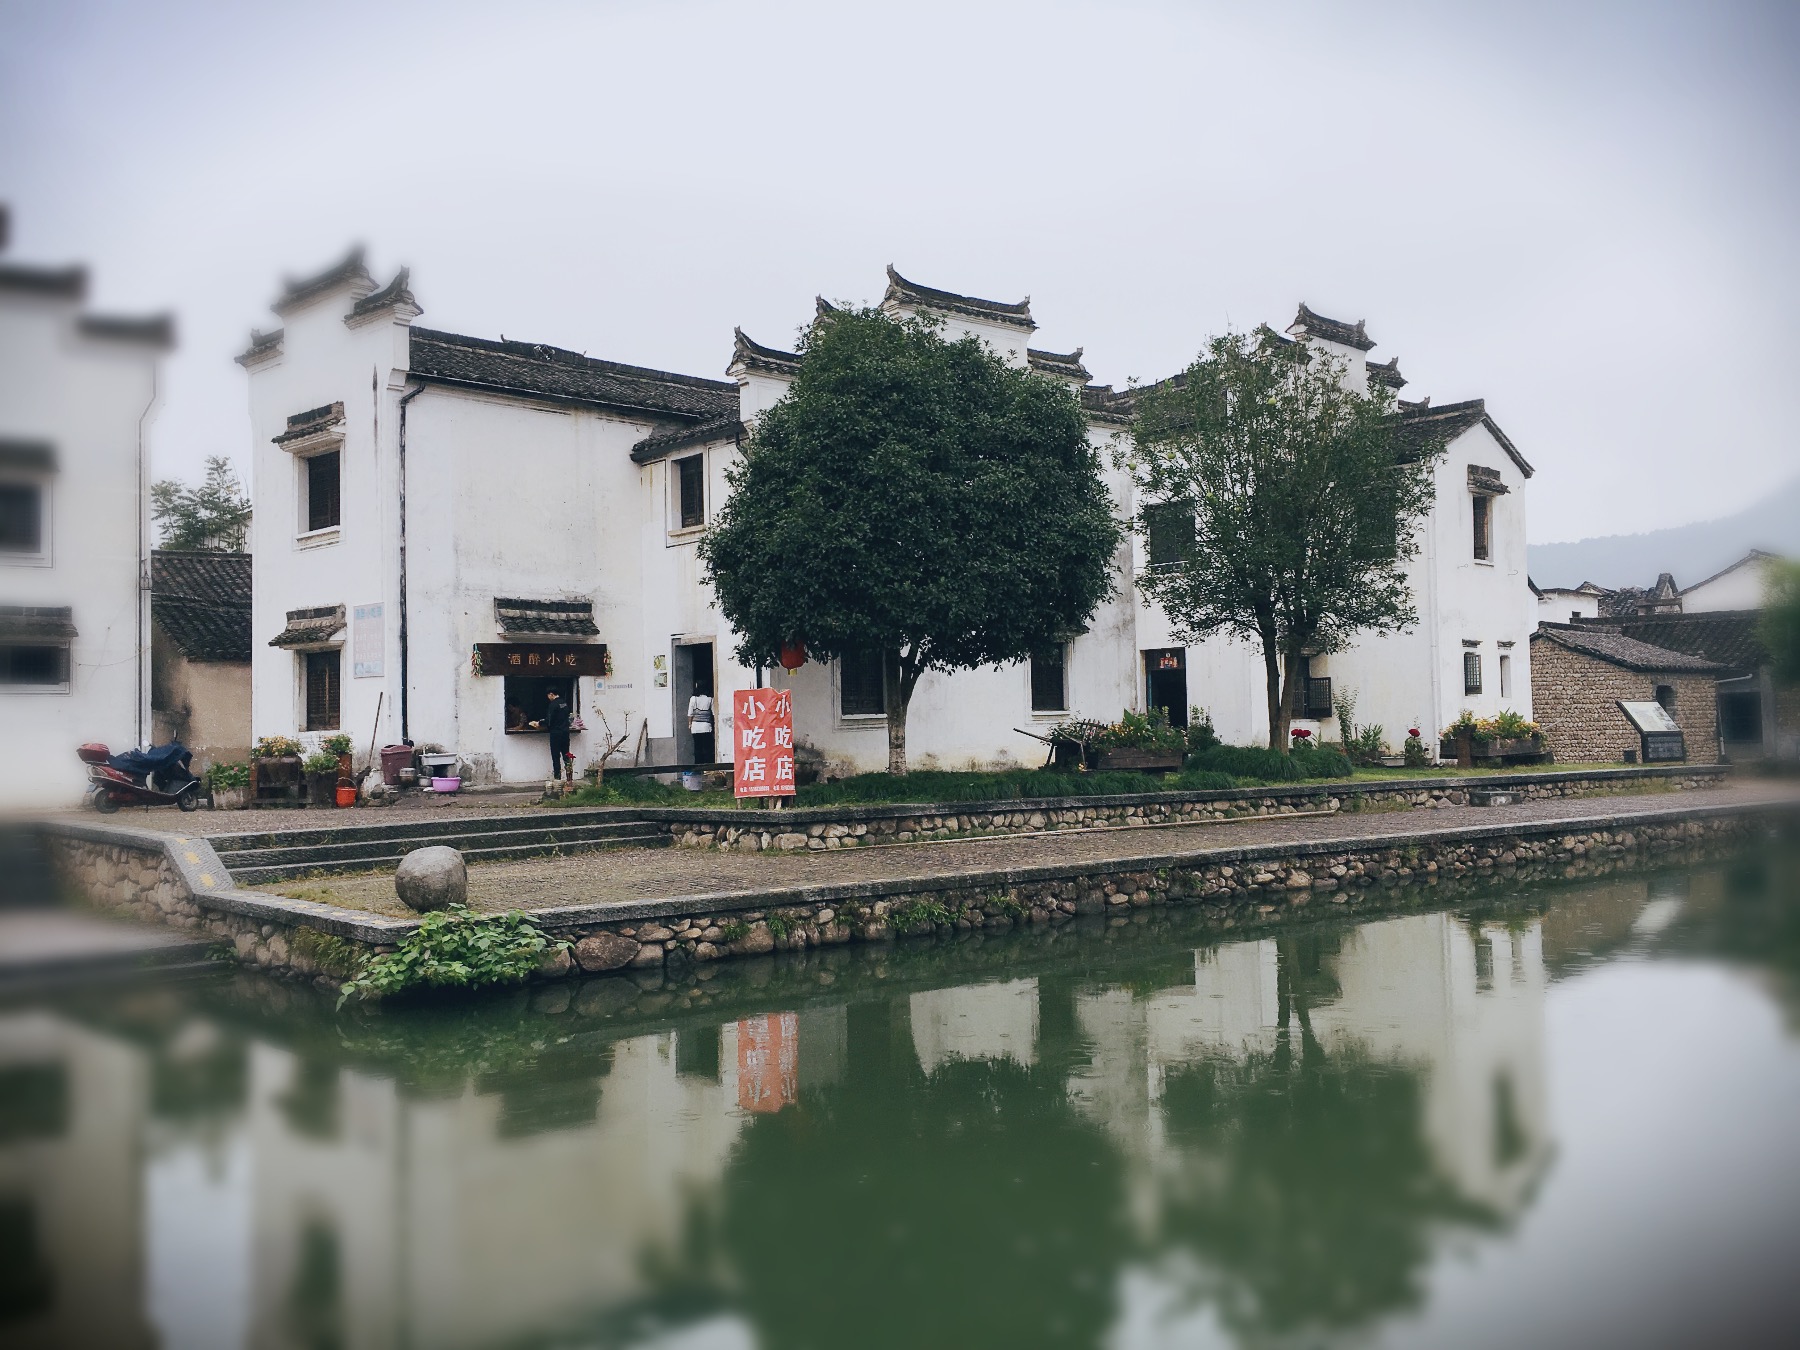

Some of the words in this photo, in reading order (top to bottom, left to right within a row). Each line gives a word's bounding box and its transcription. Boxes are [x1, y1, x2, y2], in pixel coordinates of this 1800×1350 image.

[742, 696, 766, 781] 小吃店
[775, 695, 792, 780] 小吃店
